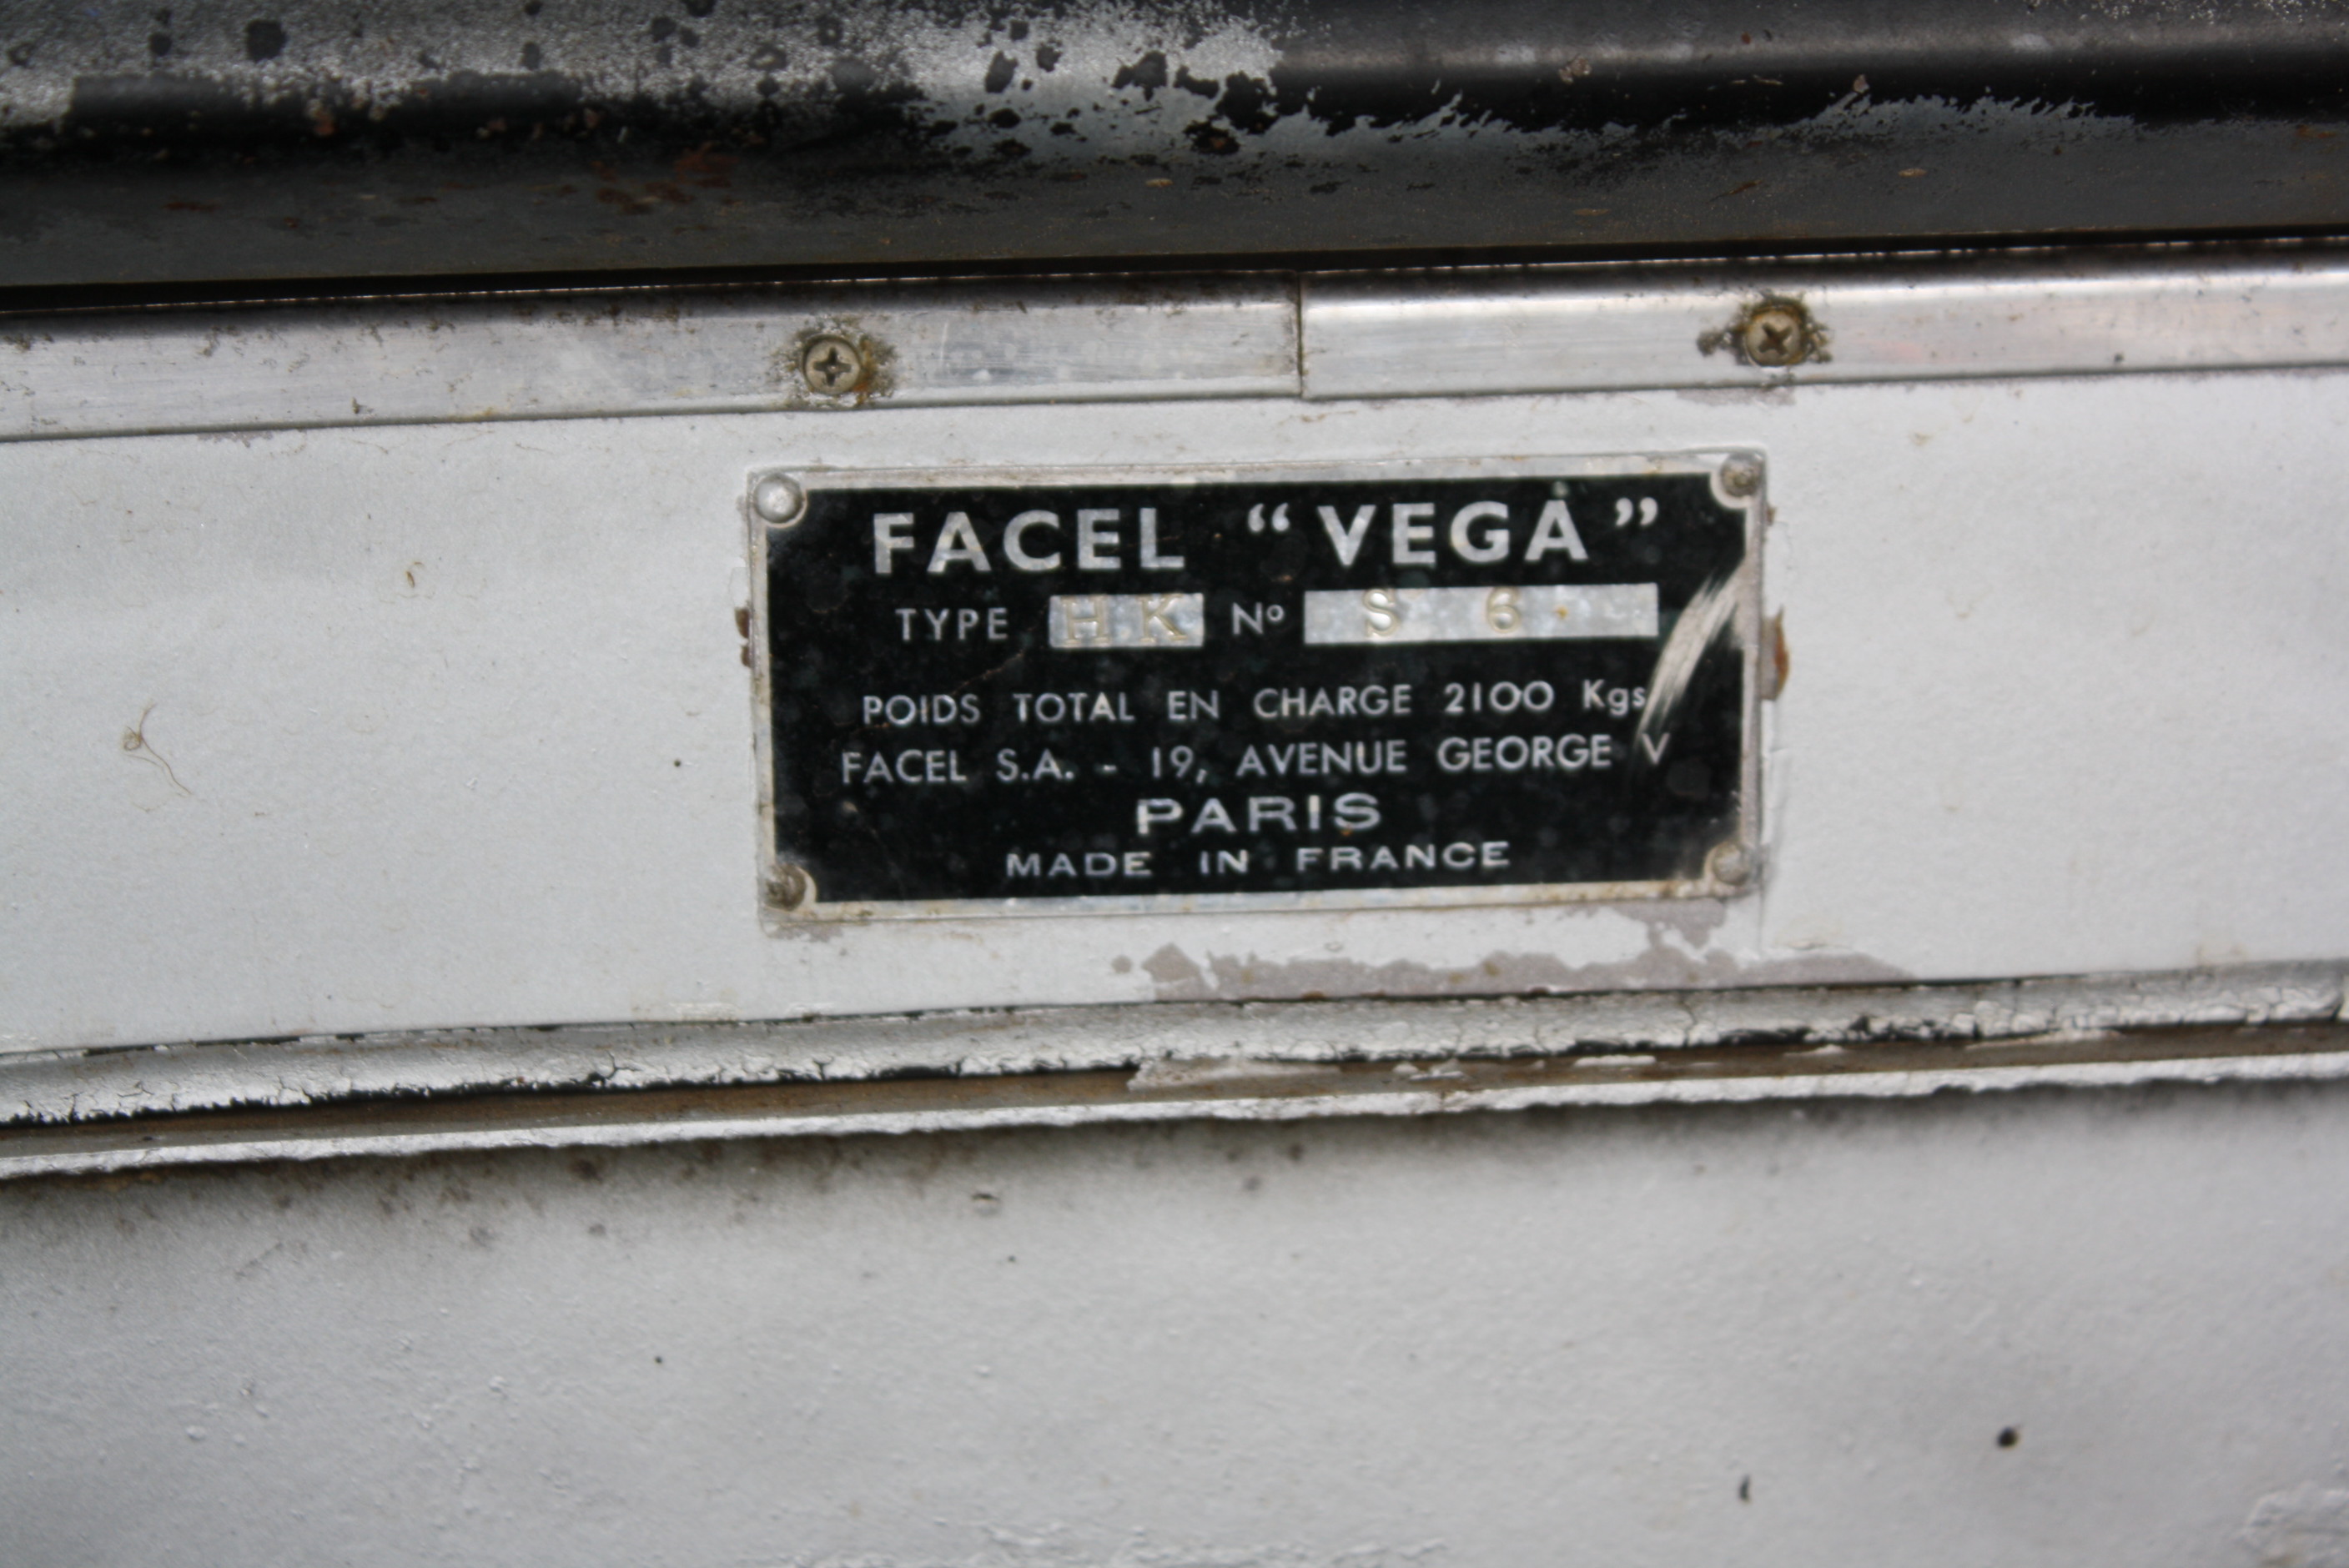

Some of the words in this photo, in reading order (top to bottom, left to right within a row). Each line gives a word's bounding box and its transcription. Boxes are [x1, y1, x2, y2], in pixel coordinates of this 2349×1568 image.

[873, 508, 1185, 574] FACEL
[896, 607, 1009, 641] TYPE
[863, 695, 980, 725] POIDS
[1013, 691, 1135, 722] TOTAL
[1169, 690, 1220, 721] EN
[1253, 684, 1412, 719] CHARGE
[1444, 681, 1555, 714] 2100
[1583, 679, 1646, 716] Kgs
[842, 750, 968, 783] FACEL
[997, 749, 1075, 782] S.A.
[1153, 745, 1207, 784] 19,
[1235, 740, 1407, 776] AVENUE
[1436, 734, 1612, 771] GEORGE
[1642, 732, 1669, 765] V
[1136, 793, 1381, 835] PARIS
[1006, 852, 1153, 877] MADE
[1200, 849, 1249, 874] IN
[1295, 841, 1511, 872] FRANCE
